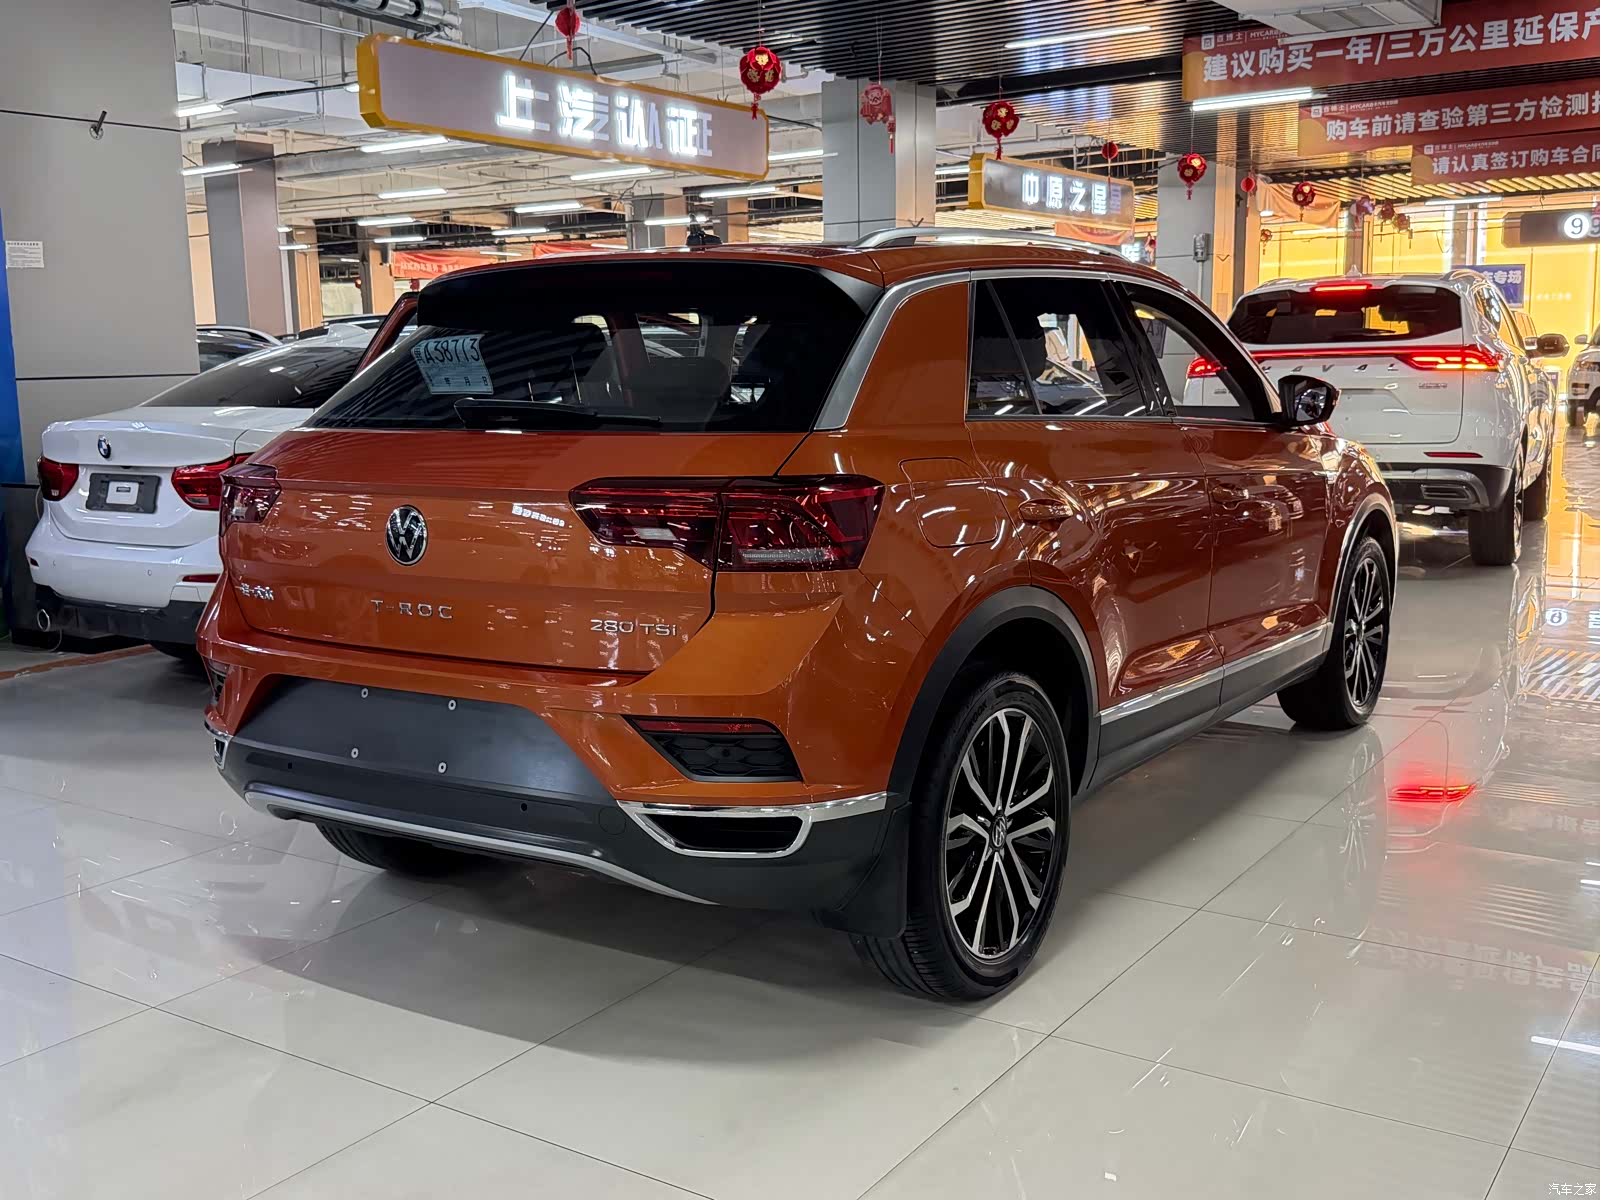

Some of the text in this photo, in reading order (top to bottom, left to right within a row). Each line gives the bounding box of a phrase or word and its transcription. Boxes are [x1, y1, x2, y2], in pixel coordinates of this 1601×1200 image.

[497, 72, 712, 158] 上汽认证
[1022, 173, 1108, 215] 中原之星
[370, 599, 453, 619] T-ROC
[590, 619, 634, 634] 280
